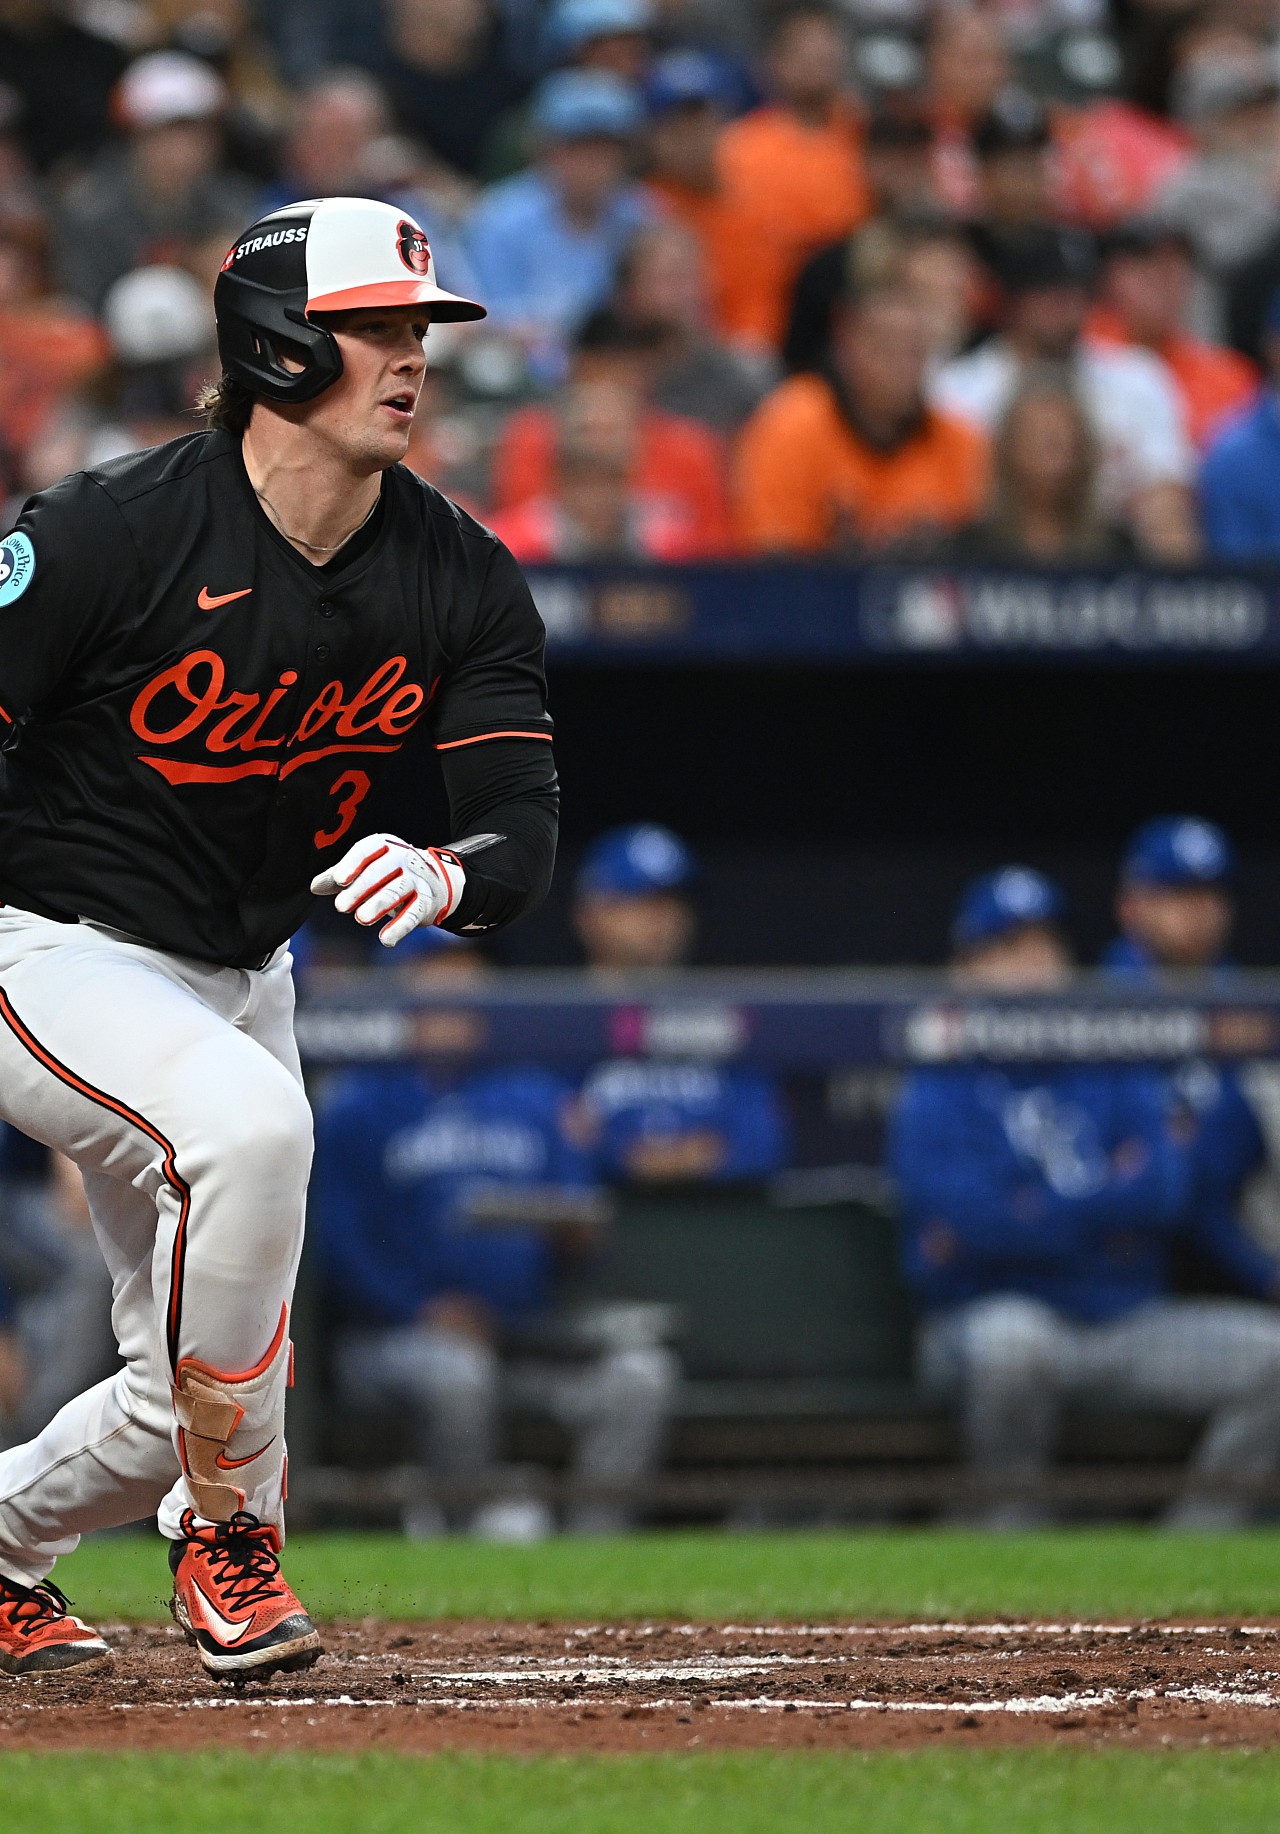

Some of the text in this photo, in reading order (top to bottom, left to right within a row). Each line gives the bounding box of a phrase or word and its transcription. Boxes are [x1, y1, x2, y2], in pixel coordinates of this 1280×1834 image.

[235, 227, 308, 260] STRAUSS
[10, 553, 31, 587] Price
[314, 769, 371, 850] 3
